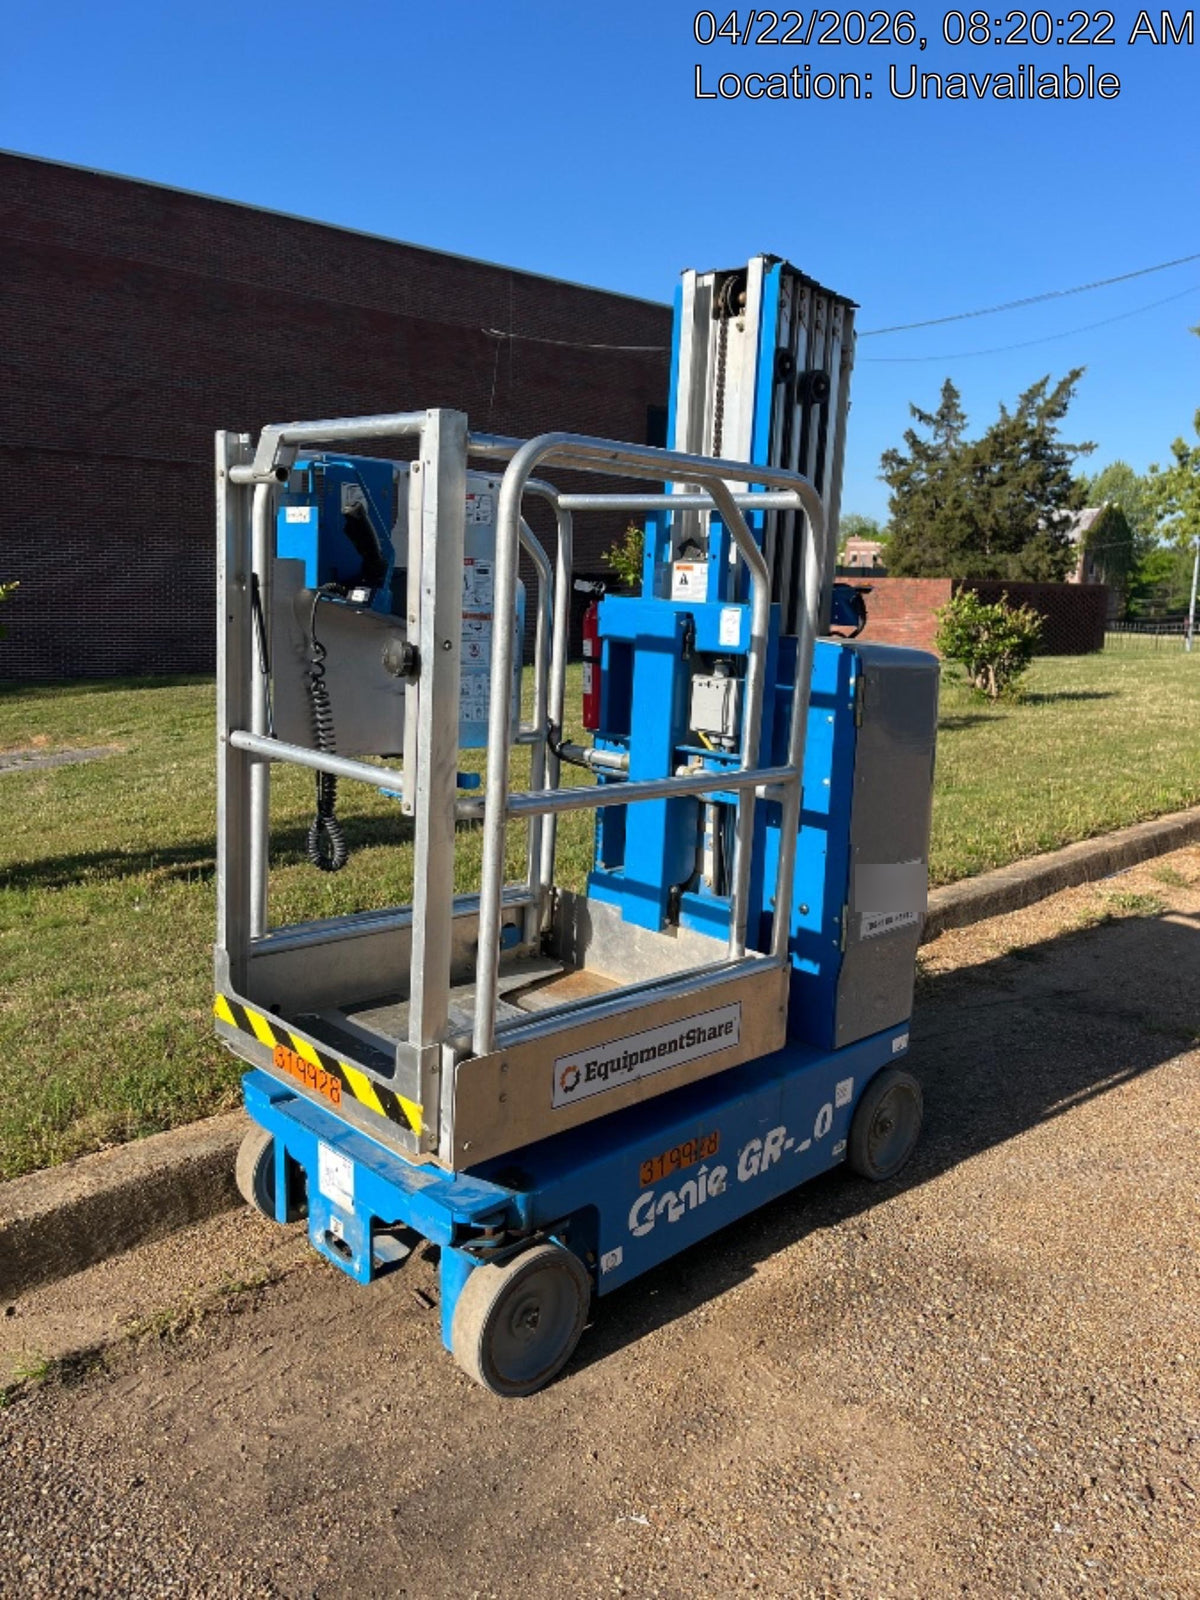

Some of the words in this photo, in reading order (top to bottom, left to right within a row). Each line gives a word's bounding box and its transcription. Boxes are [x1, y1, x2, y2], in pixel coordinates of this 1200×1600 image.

[274, 1045, 341, 1104] 319928
[584, 1019, 734, 1083] EquipmentShare
[737, 1103, 833, 1183] GR-0
